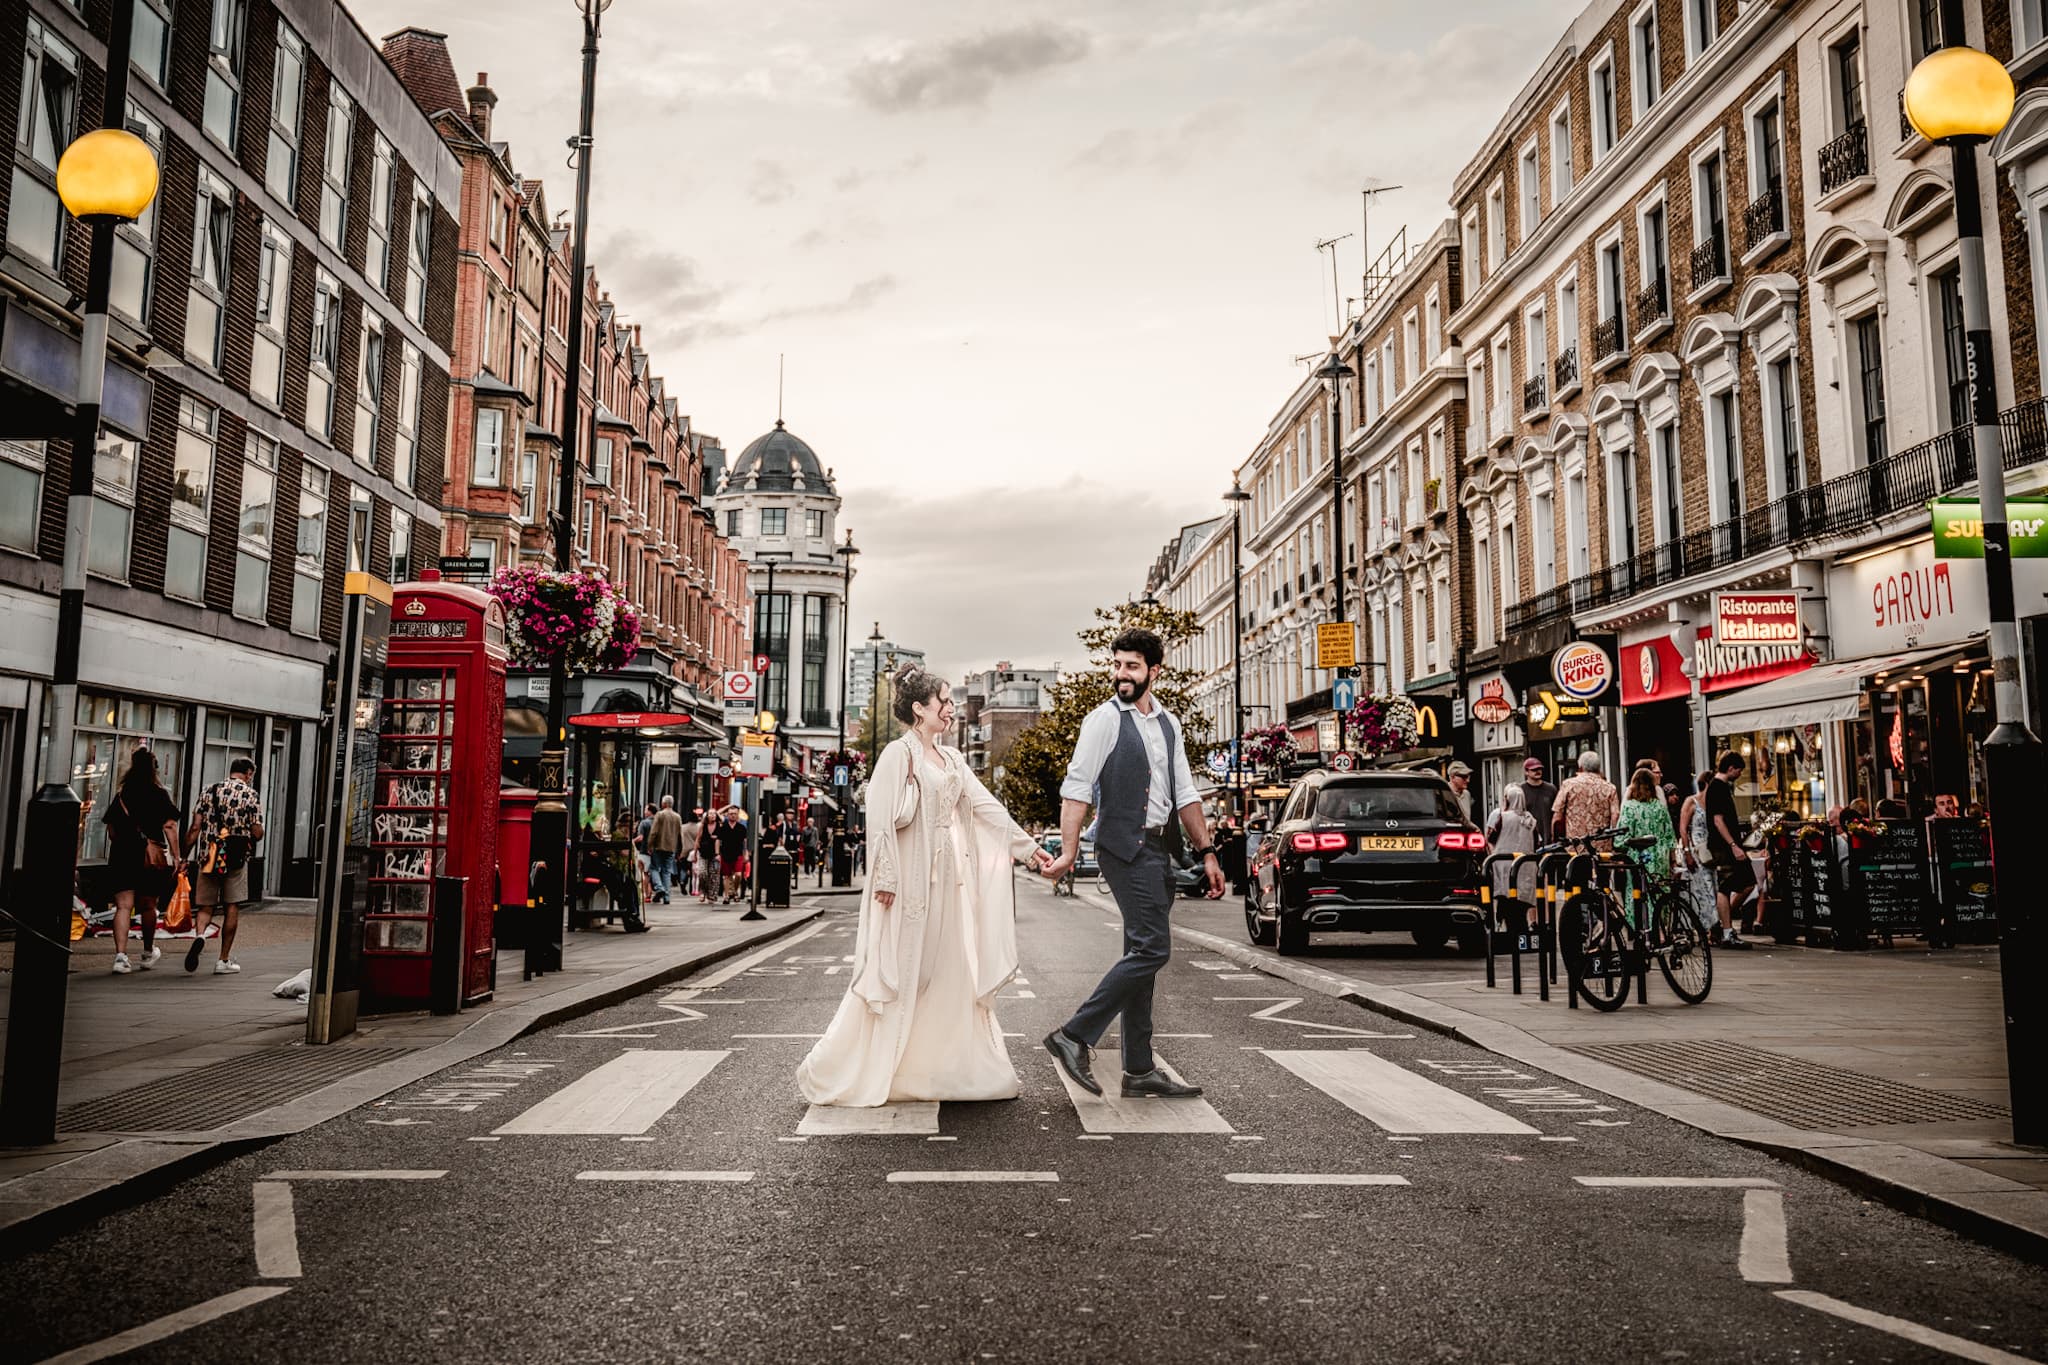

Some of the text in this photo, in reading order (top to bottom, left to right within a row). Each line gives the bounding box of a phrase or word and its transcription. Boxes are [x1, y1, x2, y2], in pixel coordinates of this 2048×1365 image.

[1944, 518, 2045, 538] SUBAY
[1720, 598, 1795, 615] Ristorante
[1721, 617, 1797, 640] Italiano
[1562, 653, 1603, 672] BURGER
[1564, 664, 1606, 686] KING
[1336, 758, 1350, 767] 20
[1368, 838, 1420, 849] LR22 XUF
